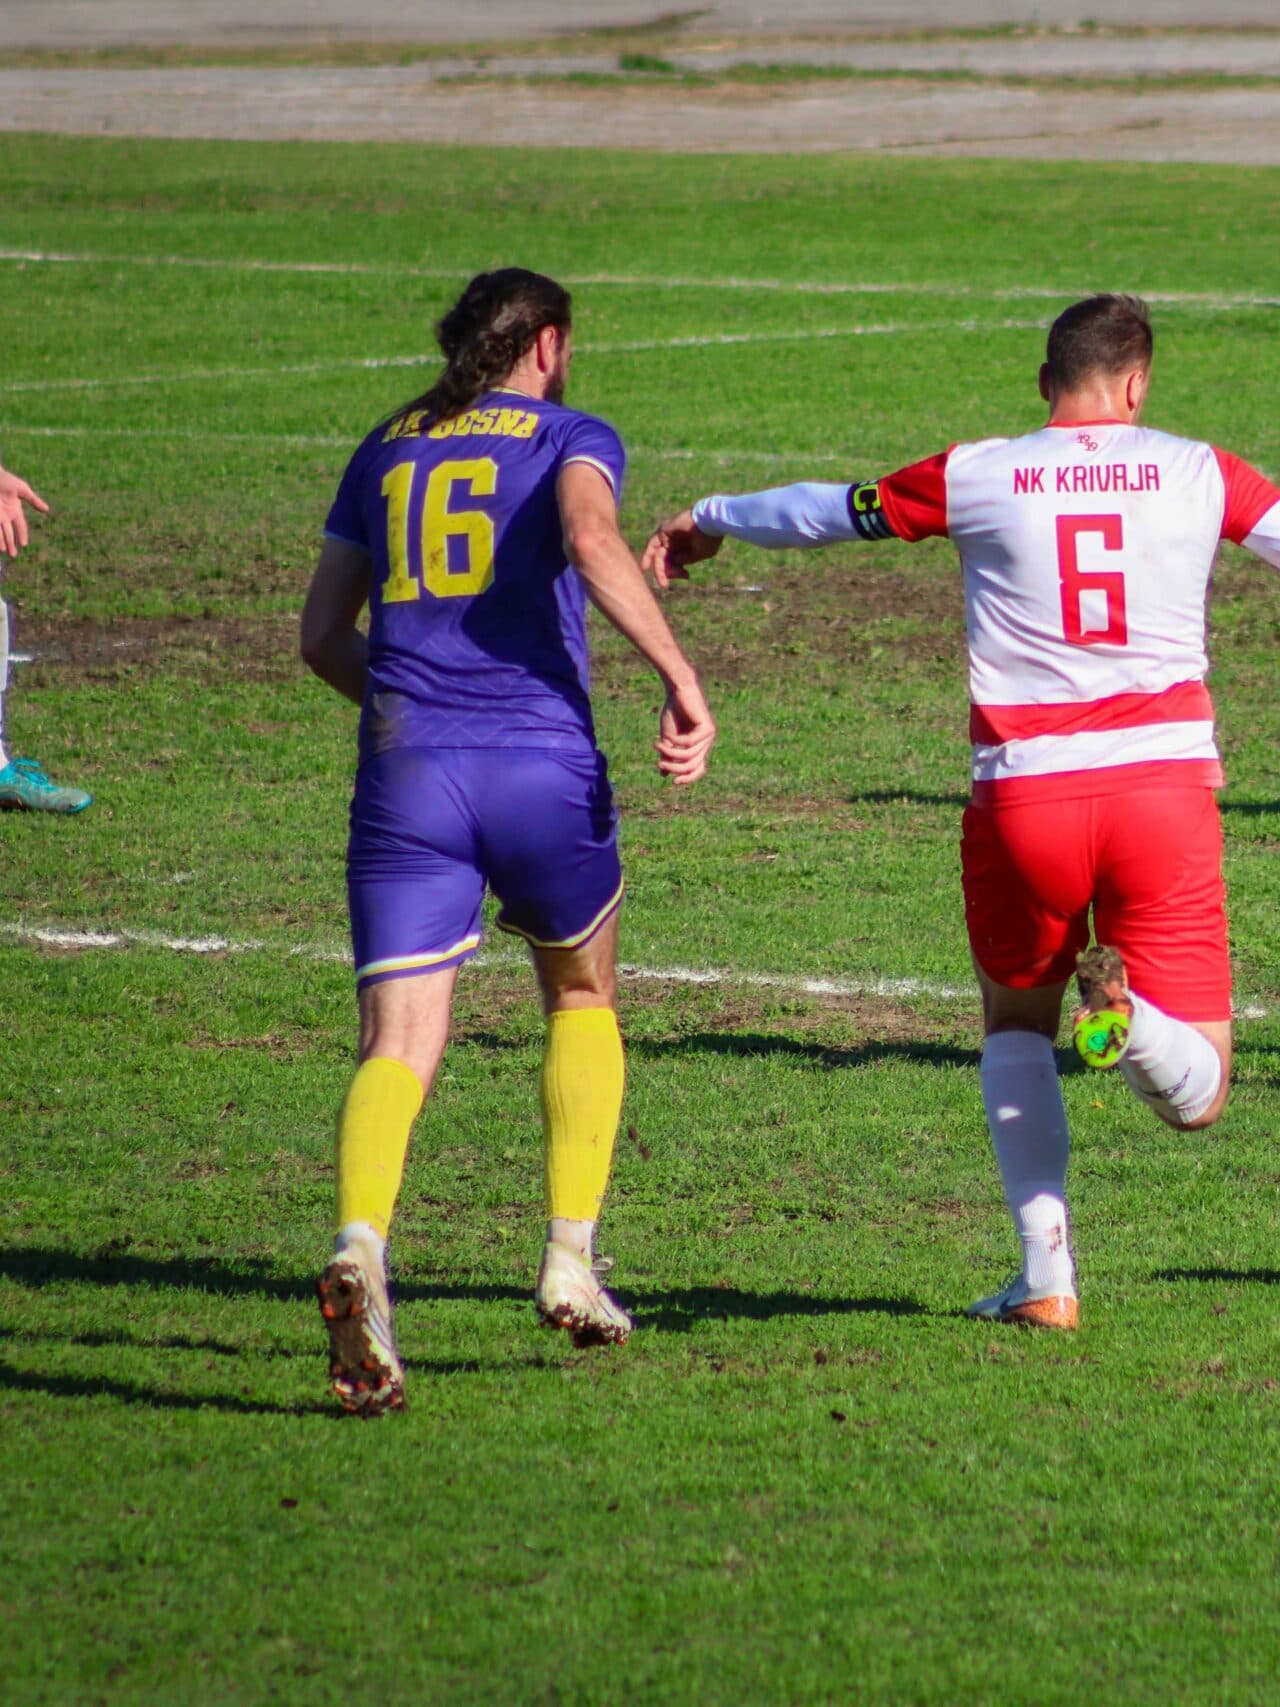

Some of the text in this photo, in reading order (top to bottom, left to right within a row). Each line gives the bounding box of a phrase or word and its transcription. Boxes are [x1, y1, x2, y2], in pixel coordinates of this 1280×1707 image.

[853, 483, 881, 512] C
[1013, 463, 1160, 494] NK KRIVAJA
[381, 457, 498, 604] 16
[1056, 513, 1128, 646] 6
